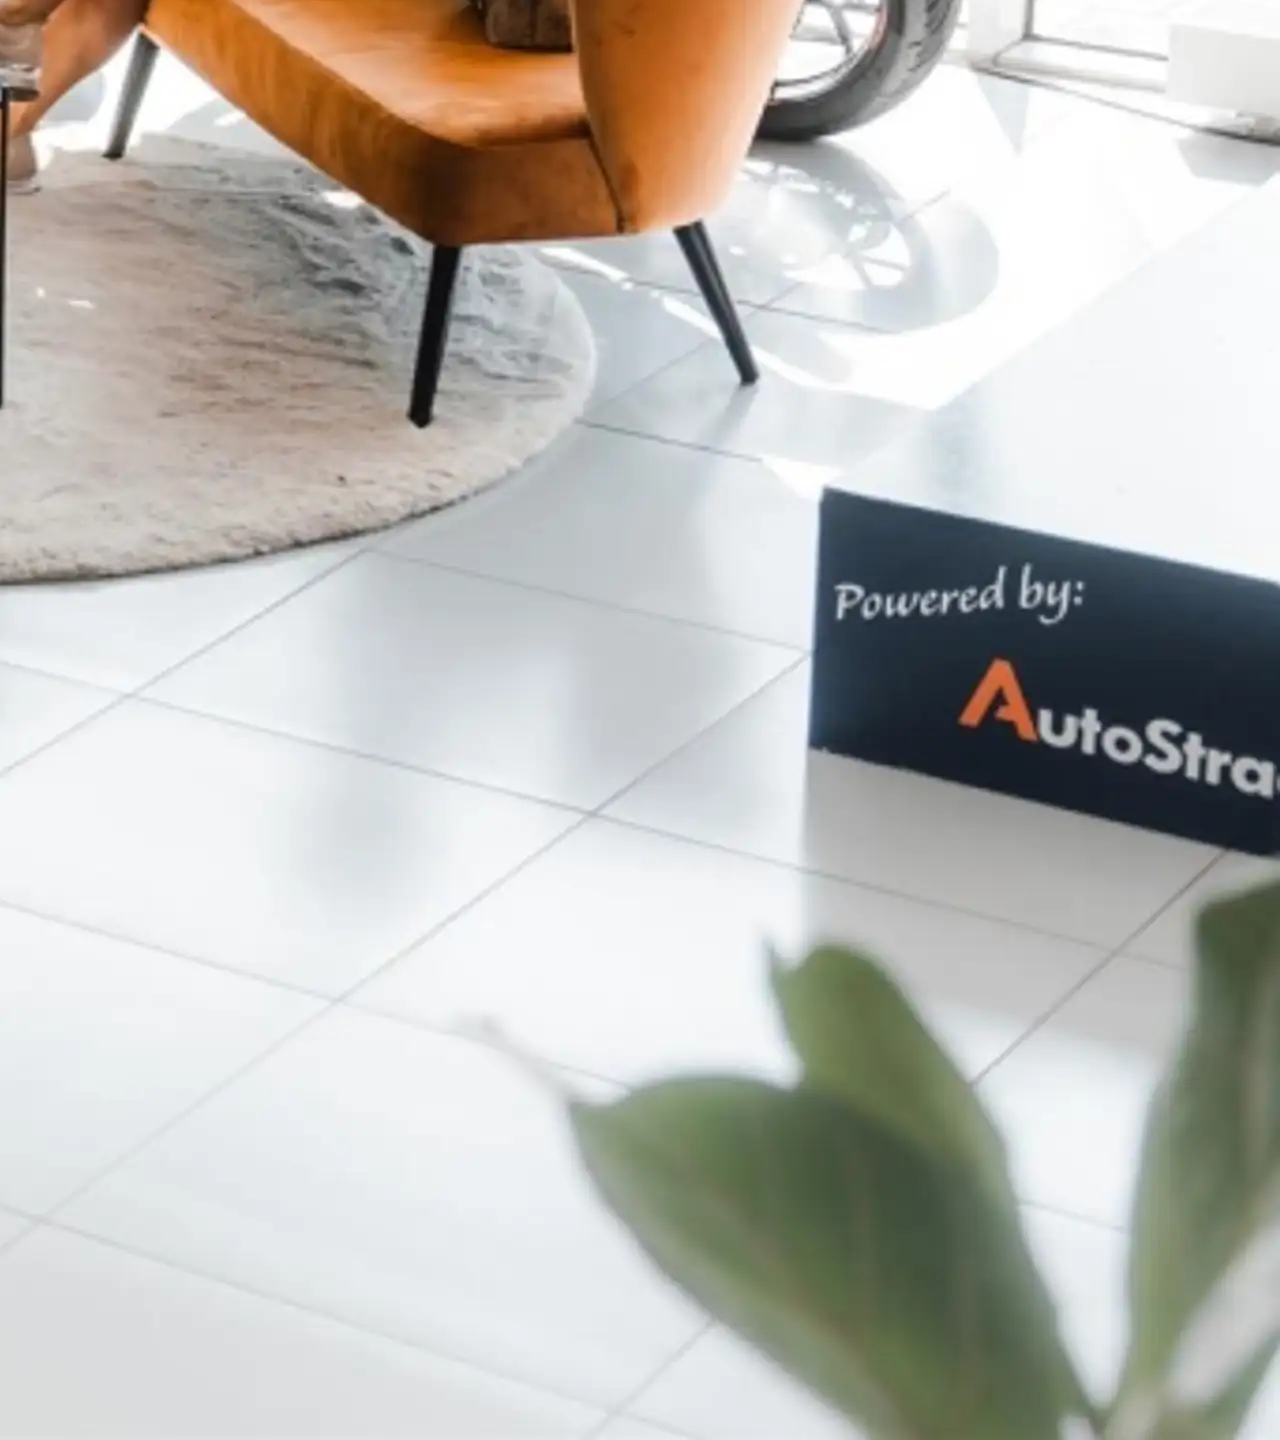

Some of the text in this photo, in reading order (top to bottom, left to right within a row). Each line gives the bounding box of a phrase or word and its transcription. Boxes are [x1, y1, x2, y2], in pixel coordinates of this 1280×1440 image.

[833, 562, 1086, 625] Powered by:
[957, 656, 1280, 800] AutoStra
